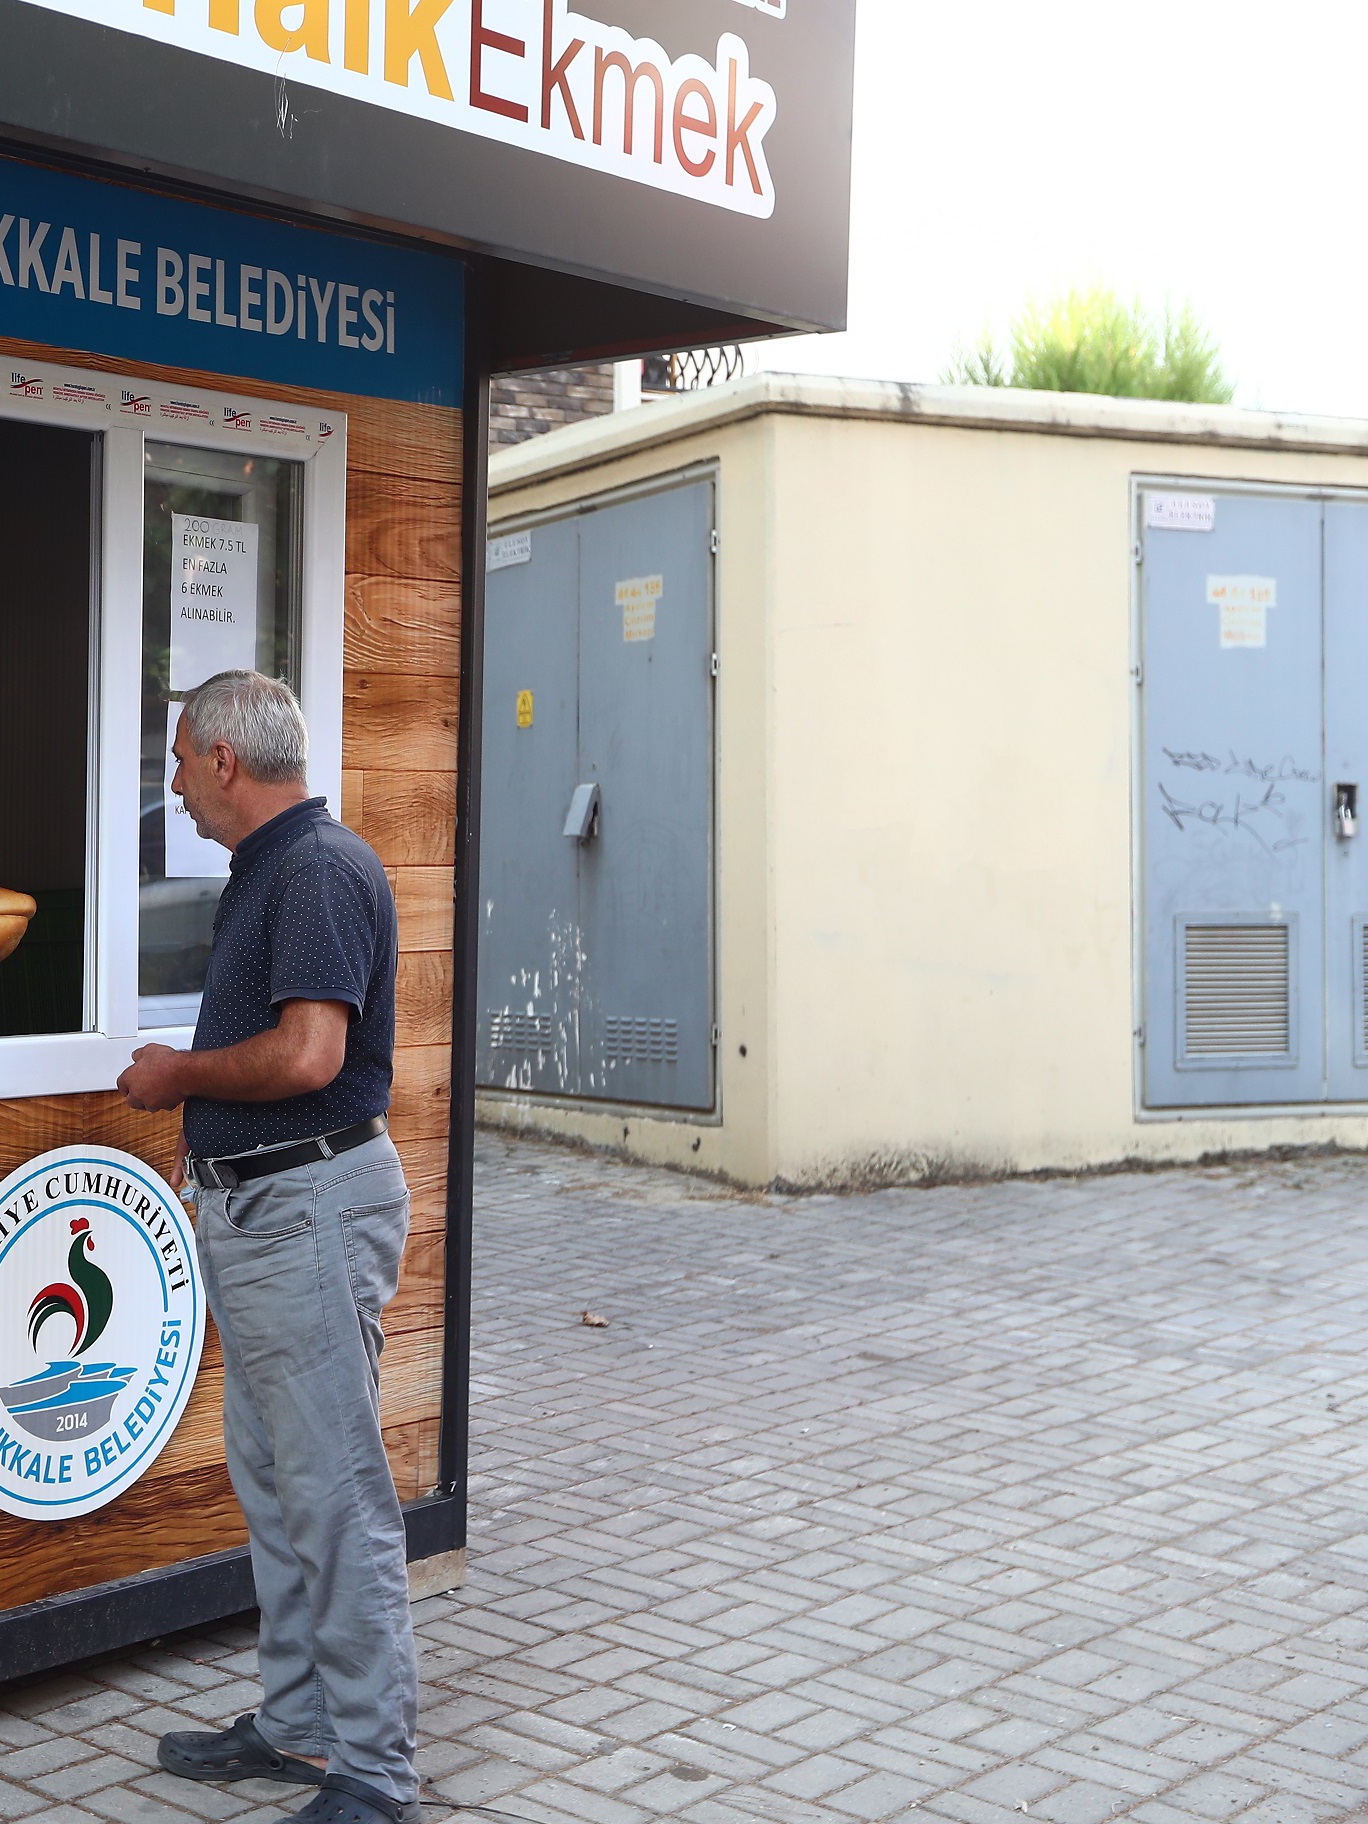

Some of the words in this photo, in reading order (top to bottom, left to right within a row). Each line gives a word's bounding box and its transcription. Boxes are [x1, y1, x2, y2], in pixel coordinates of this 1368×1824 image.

[11, 372, 26, 384] life
[25, 386, 43, 396] pen
[121, 390, 135, 402] life
[133, 403, 150, 413] pen
[224, 407, 237, 418] life
[235, 419, 251, 429] pen
[184, 518, 210, 533] 200
[212, 523, 243, 536] GRAM
[183, 534, 216, 549] EKMEK
[219, 538, 233, 552] 7.5
[236, 541, 247, 553] TL
[183, 558, 195, 570] EN
[198, 560, 227, 574] FAZLA
[181, 581, 188, 594] 6
[190, 583, 223, 597] EKMEK
[181, 606, 235, 623] ALINABİLİR.
[45, 1172, 189, 1293] CUMHURİYETİ
[56, 1412, 88, 1432] 2014
